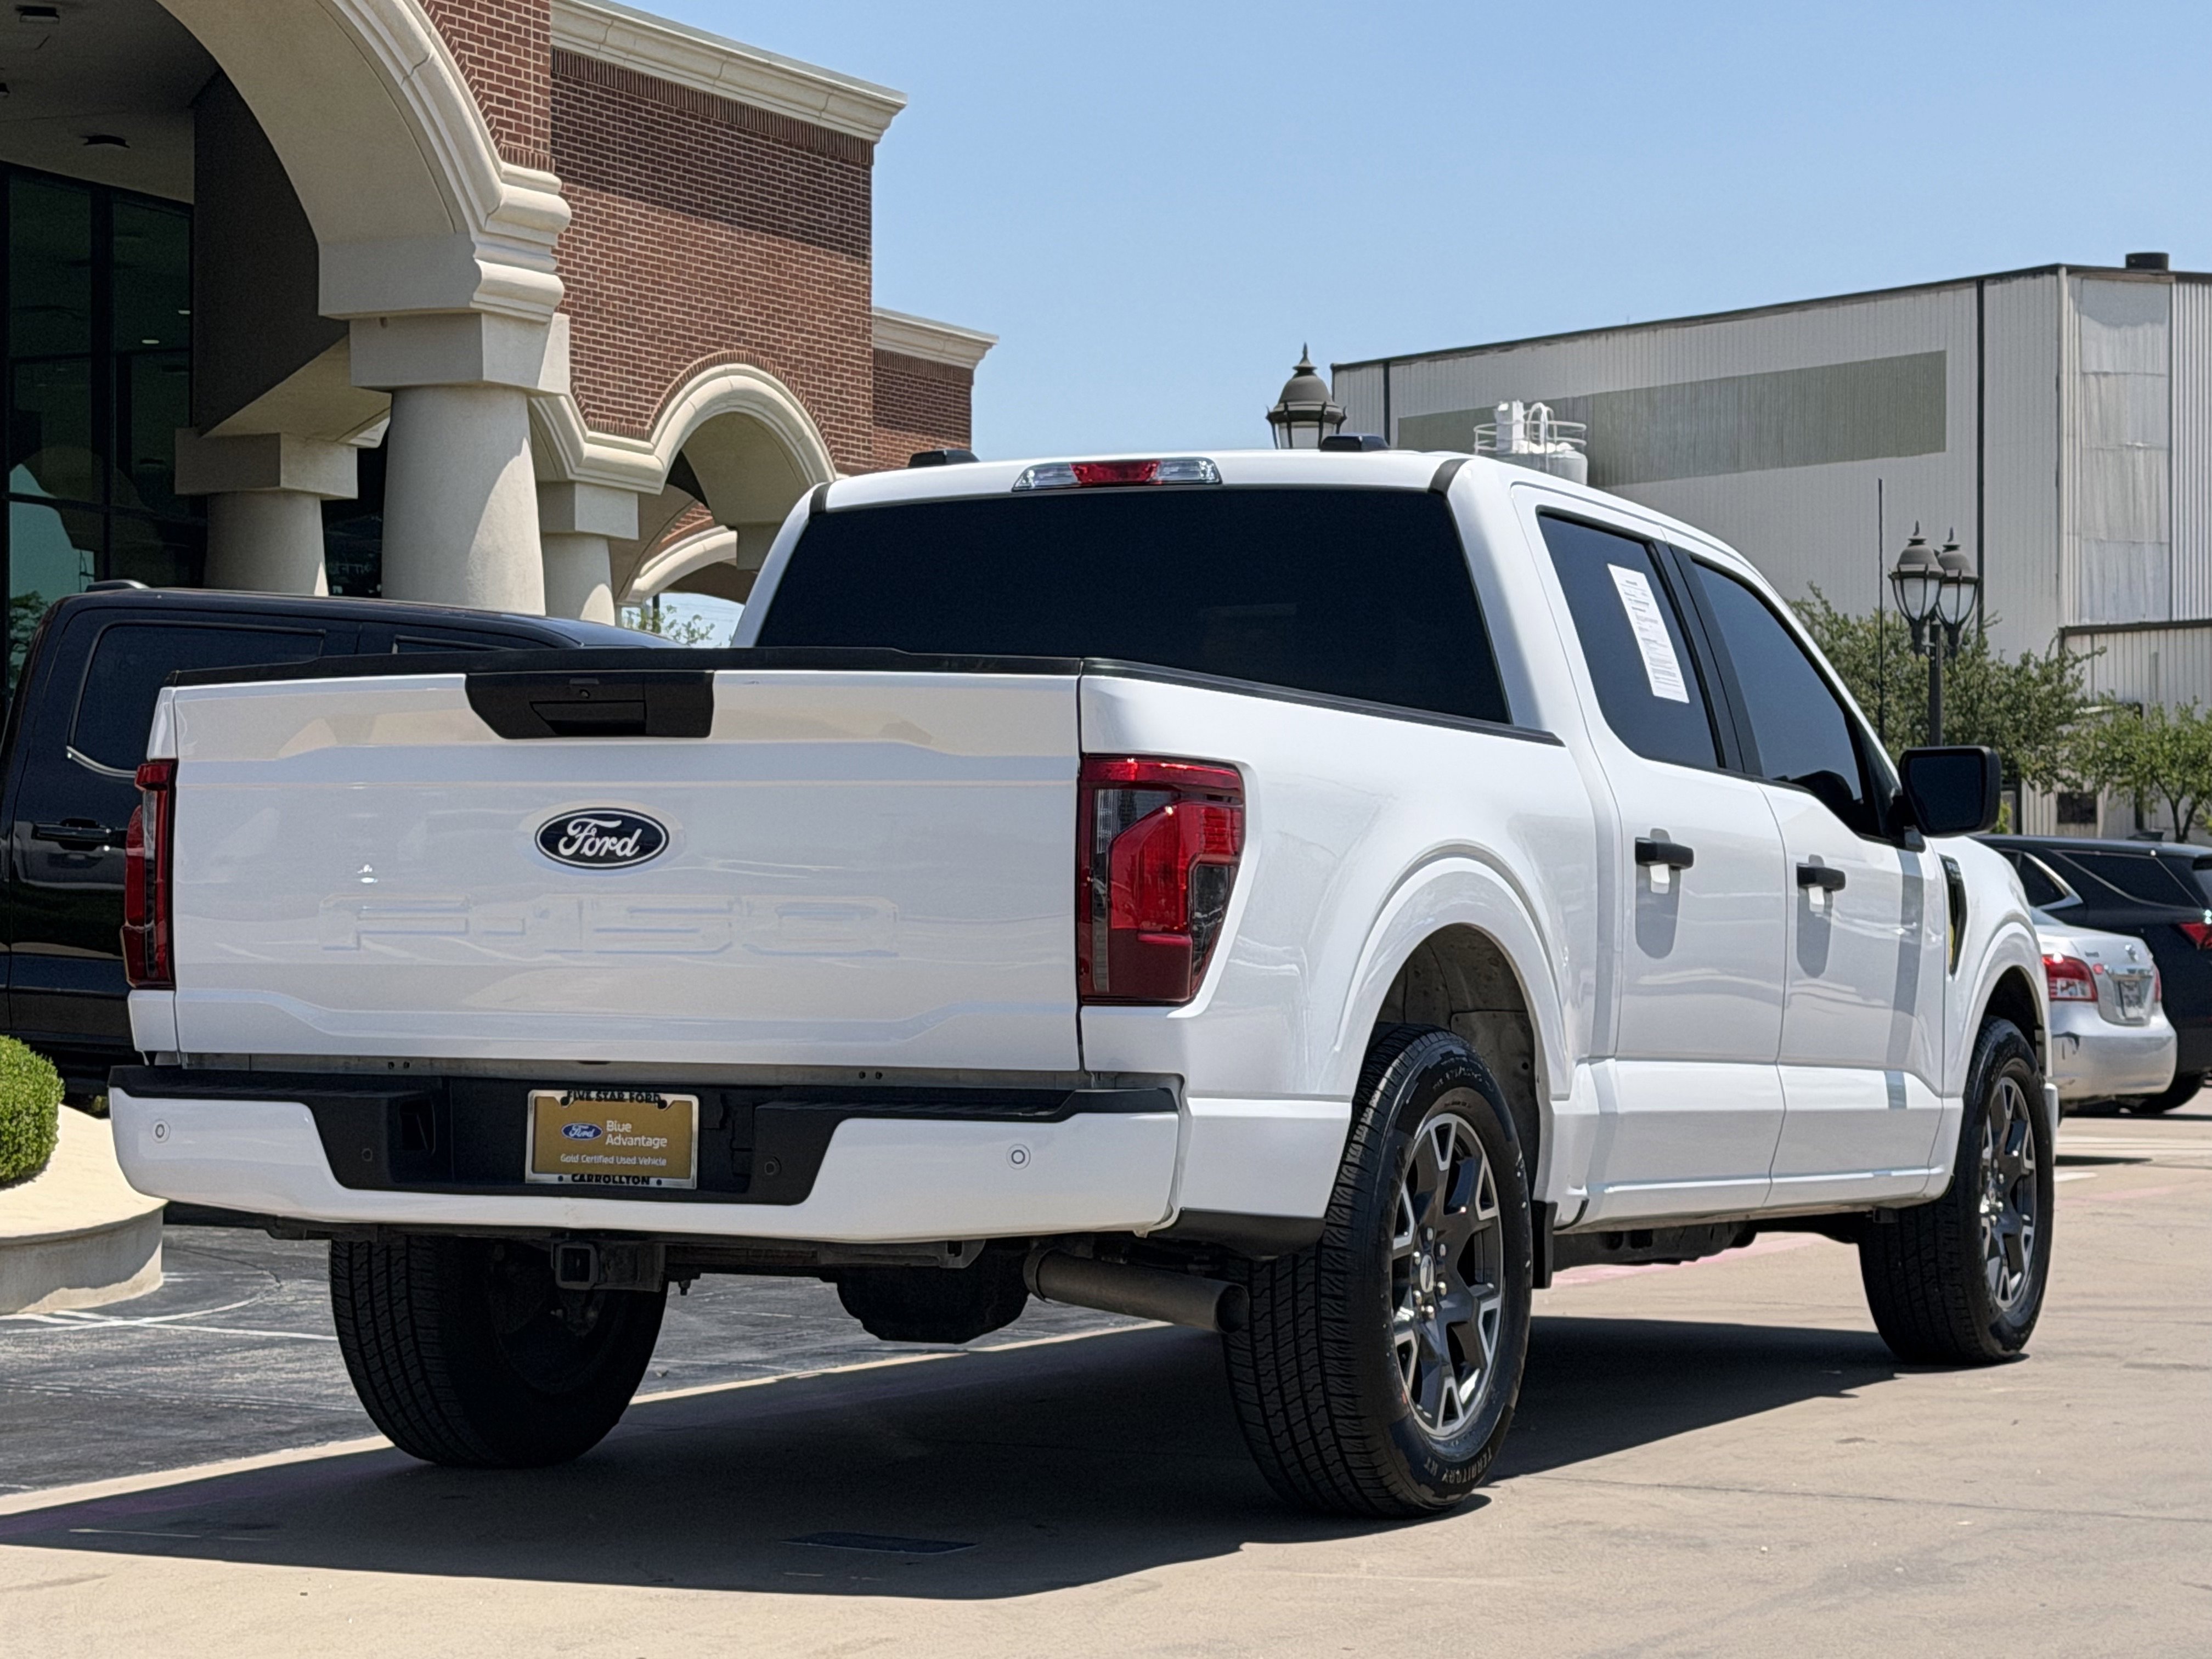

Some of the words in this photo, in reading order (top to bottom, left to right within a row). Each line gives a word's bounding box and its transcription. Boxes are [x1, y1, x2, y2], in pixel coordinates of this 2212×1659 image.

[558, 818, 642, 856] Ford
[568, 1090, 591, 1101] FIVE
[596, 1090, 625, 1102] STAR
[629, 1092, 661, 1103] FORD
[568, 1124, 595, 1138] Ford
[606, 1120, 632, 1132] Blue
[606, 1134, 668, 1150] Advantage
[560, 1153, 579, 1164] Gold
[581, 1154, 614, 1165] Certified
[616, 1155, 637, 1166] Used
[638, 1156, 667, 1167] Vehicle
[571, 1174, 651, 1186] CARROLLTON
[1442, 1446, 1492, 1483] TERRITORY
